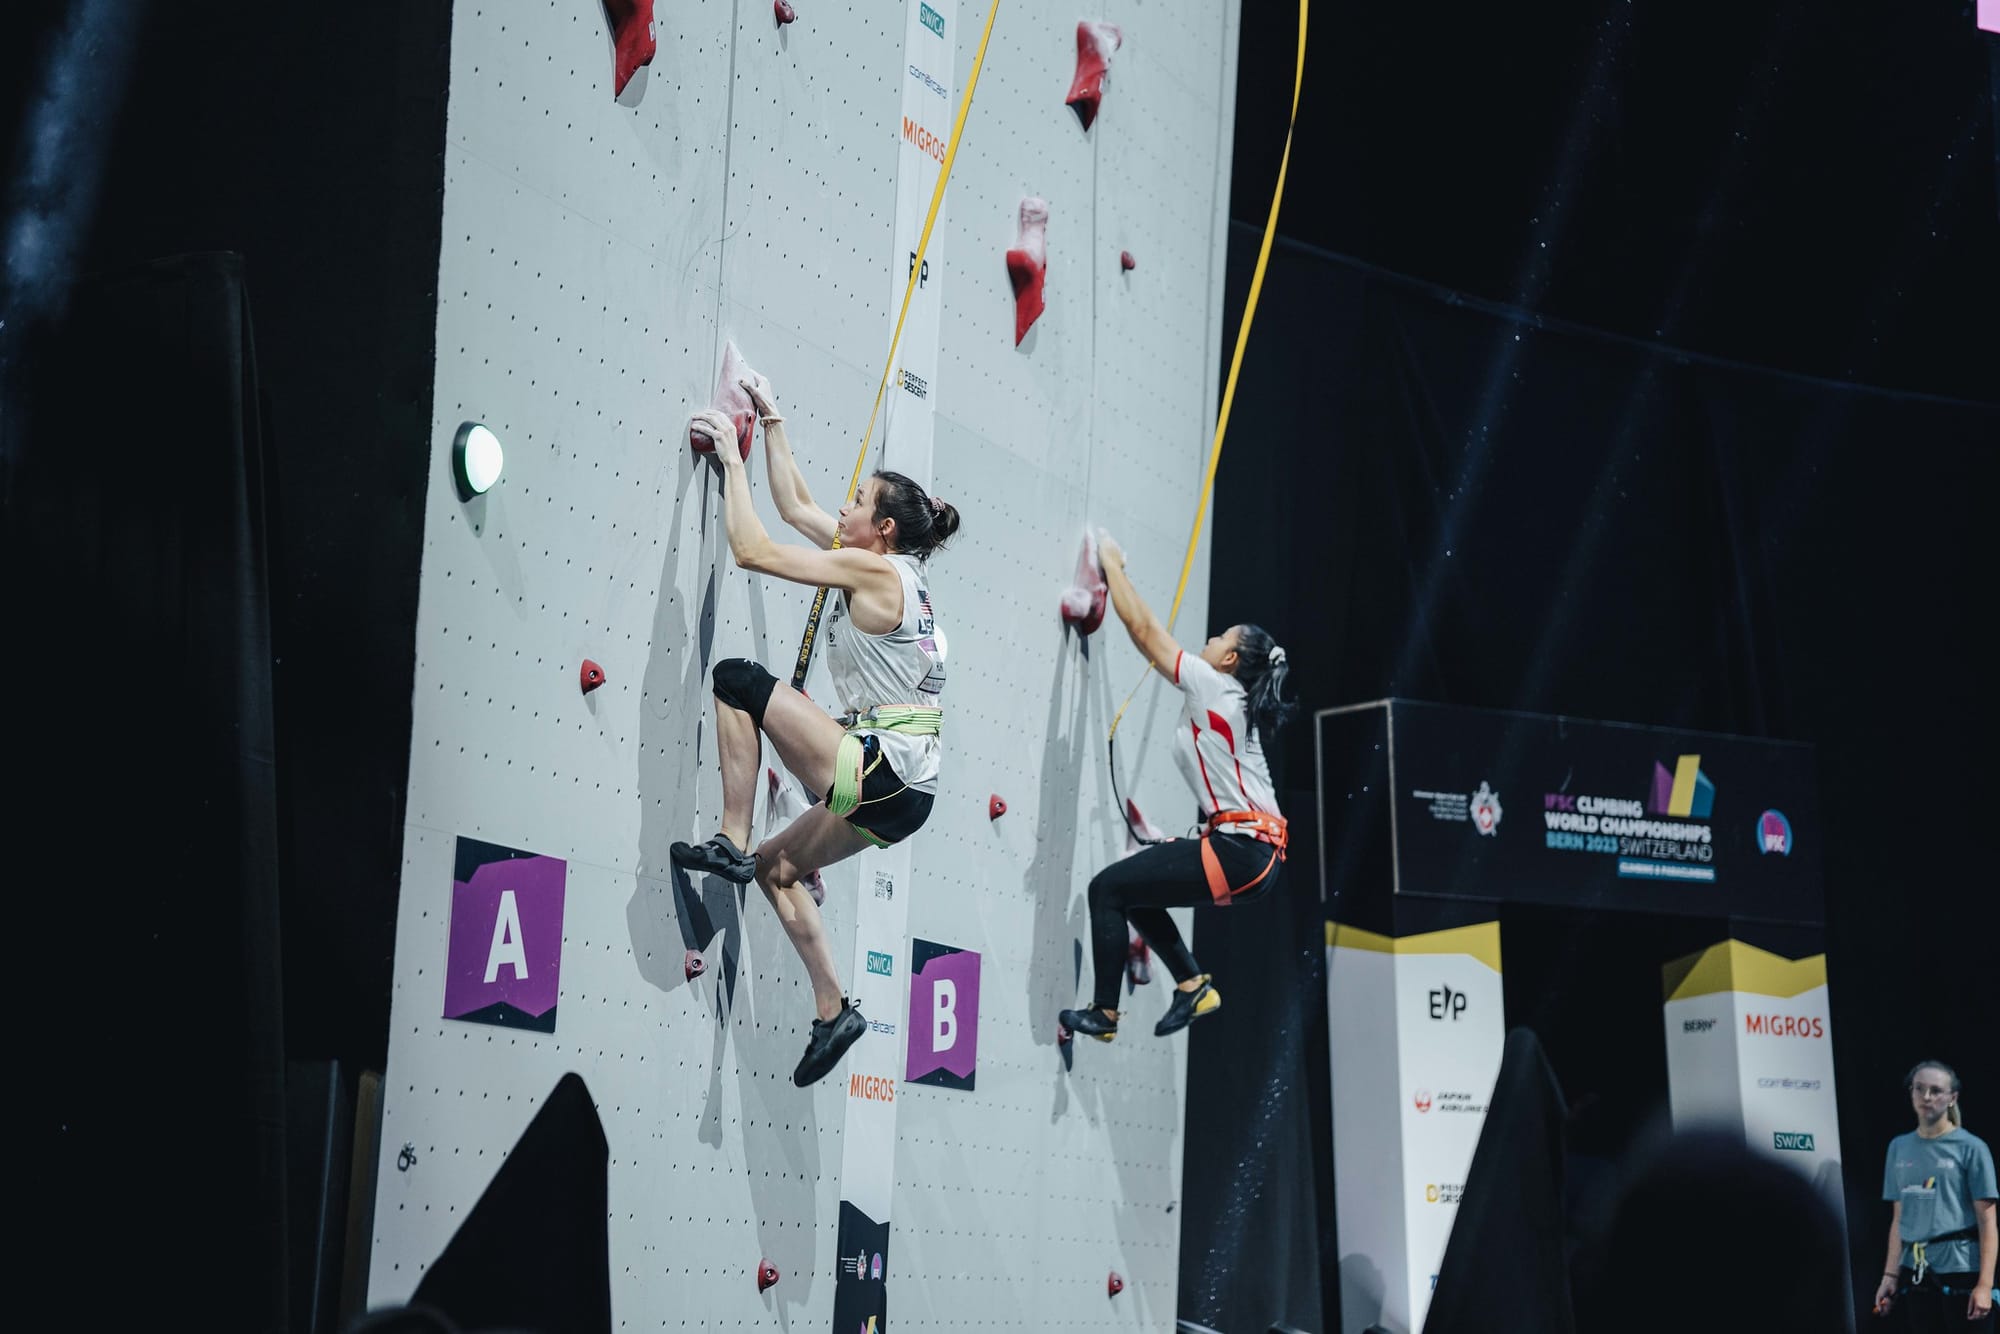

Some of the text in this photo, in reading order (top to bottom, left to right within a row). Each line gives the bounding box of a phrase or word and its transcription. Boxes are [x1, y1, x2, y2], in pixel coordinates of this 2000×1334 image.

[921, 5, 944, 37] SWICA
[904, 116, 945, 165] MIGROS
[904, 380, 926, 400] DESCENT
[905, 370, 927, 389] PERFECT
[811, 586, 825, 622] ERFECT
[1577, 796, 1643, 818] CLIMBING
[1545, 812, 1712, 843] WORLD CHAMPIONSHIPS
[1546, 831, 1713, 862] BERN 2023 SWITZERLAND
[483, 889, 528, 984] A
[867, 954, 893, 975] SWICA
[932, 978, 957, 1053] B
[1746, 1014, 1824, 1038] MIGROS
[850, 1073, 894, 1102] MIGROS
[1775, 1133, 1814, 1150] SWICA
